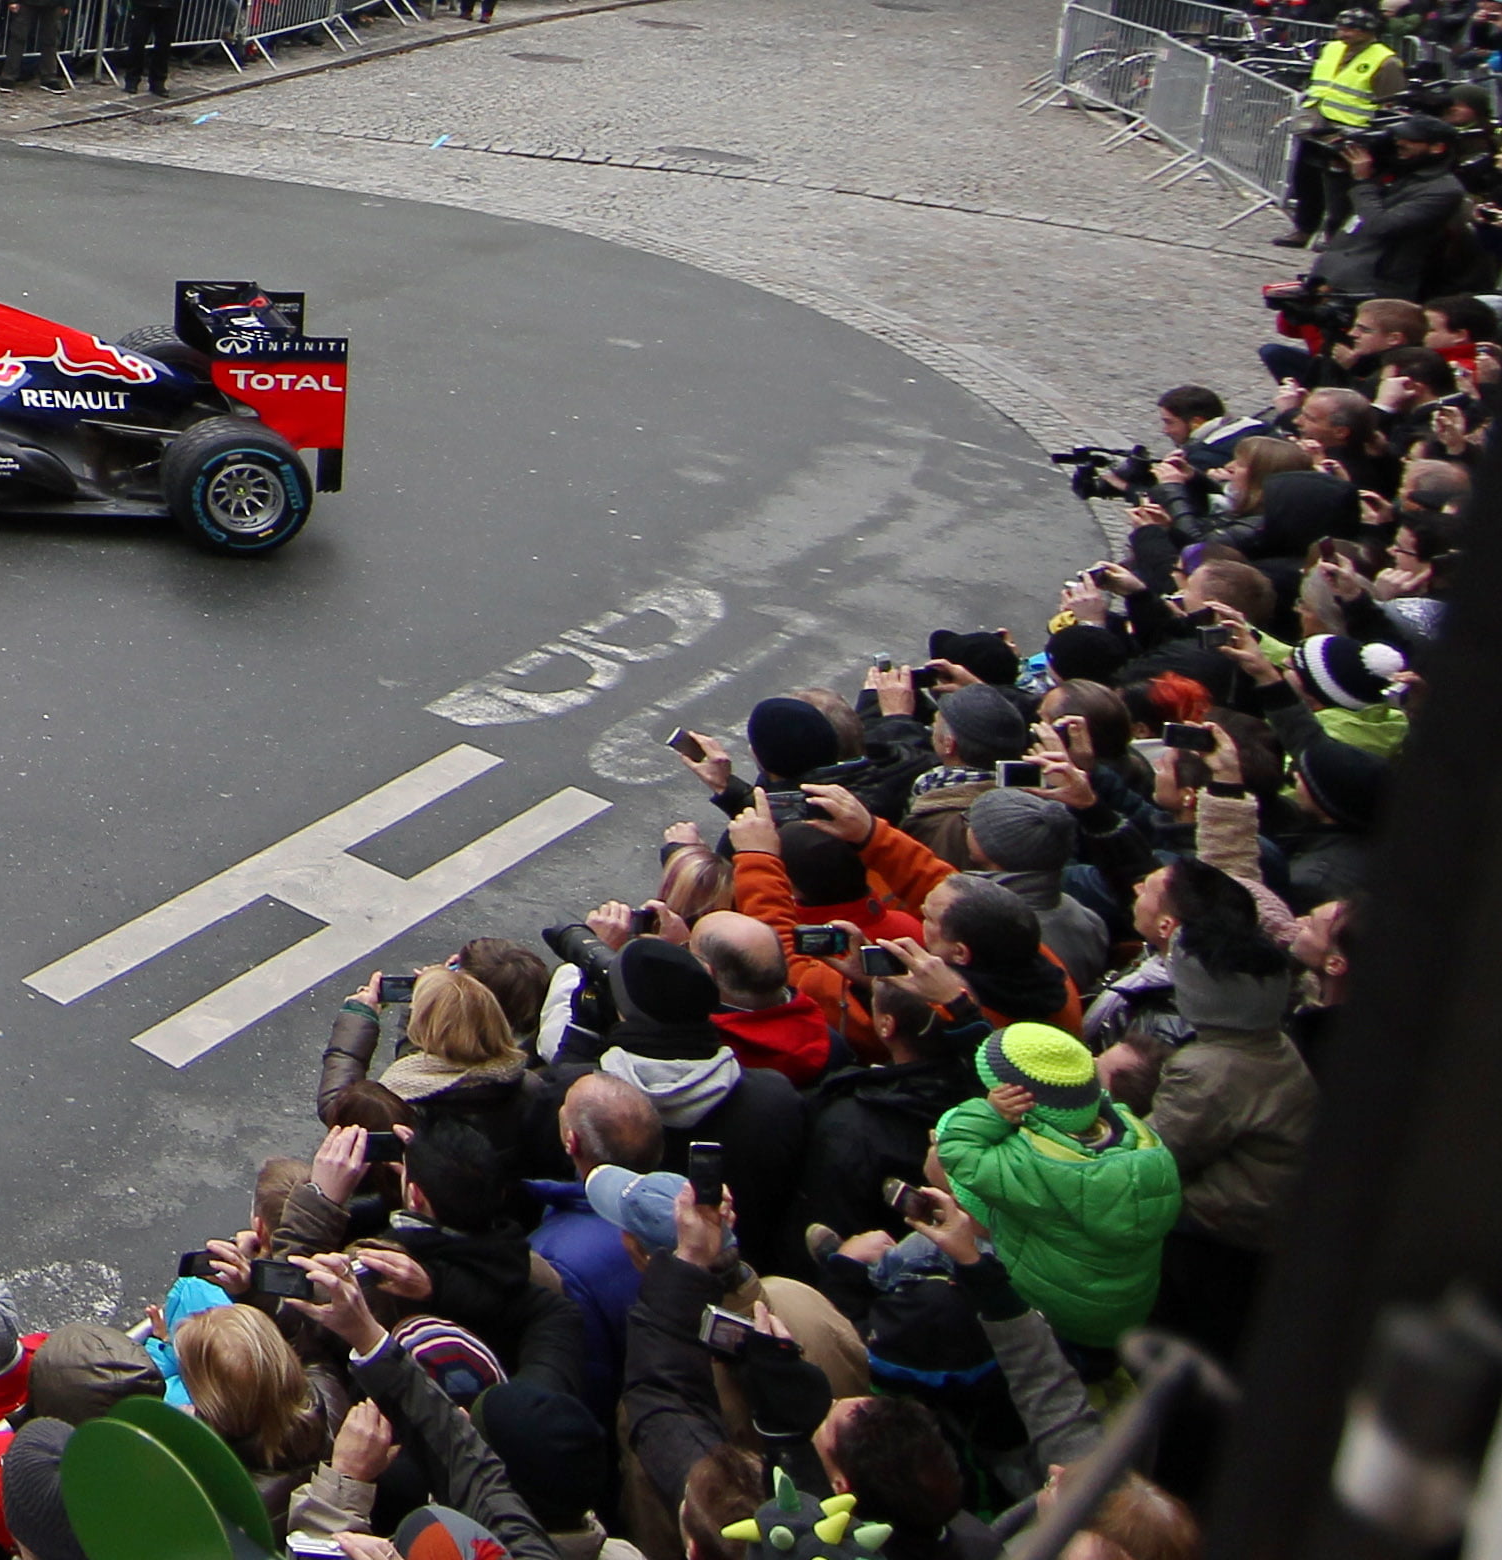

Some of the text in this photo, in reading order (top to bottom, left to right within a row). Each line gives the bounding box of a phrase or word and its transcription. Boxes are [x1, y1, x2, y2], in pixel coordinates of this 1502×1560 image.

[259, 341, 346, 353] INFINITI
[228, 369, 343, 393] TOTAL
[20, 389, 130, 410] RENAULT
[21, 743, 614, 1069] H
